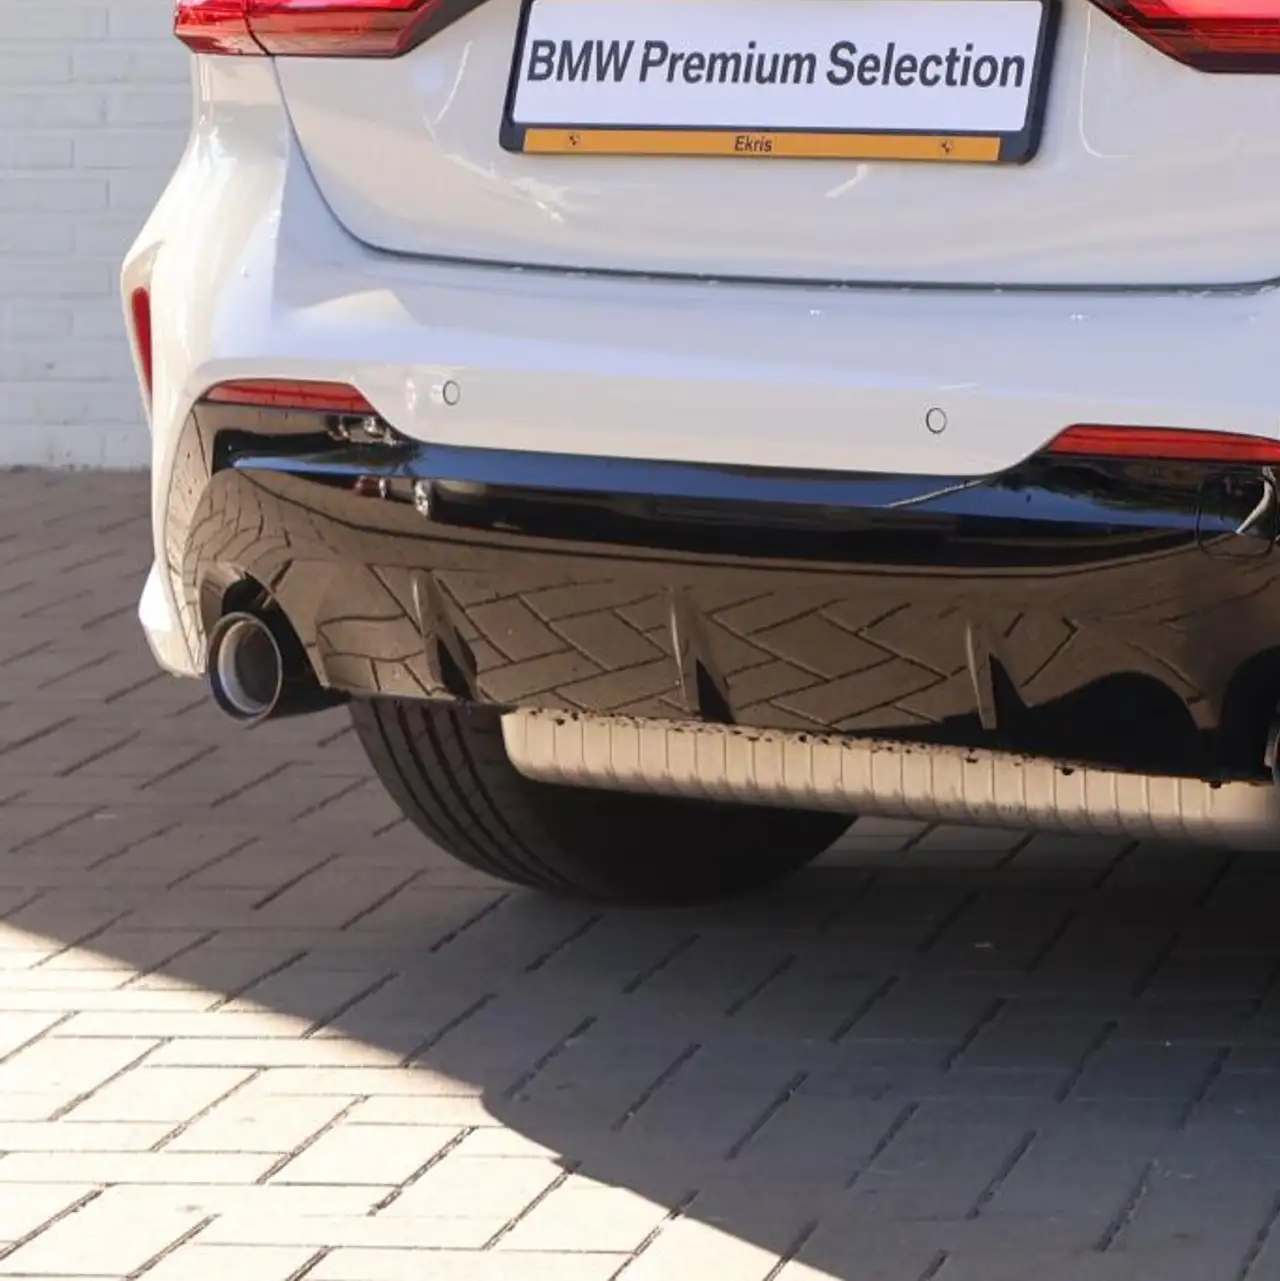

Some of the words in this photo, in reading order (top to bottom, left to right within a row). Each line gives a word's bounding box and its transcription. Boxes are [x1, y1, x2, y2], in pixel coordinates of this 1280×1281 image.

[526, 39, 635, 83] BMW
[639, 39, 817, 84] Premium
[825, 40, 1025, 87] Selection
[734, 135, 773, 152] Ekris
